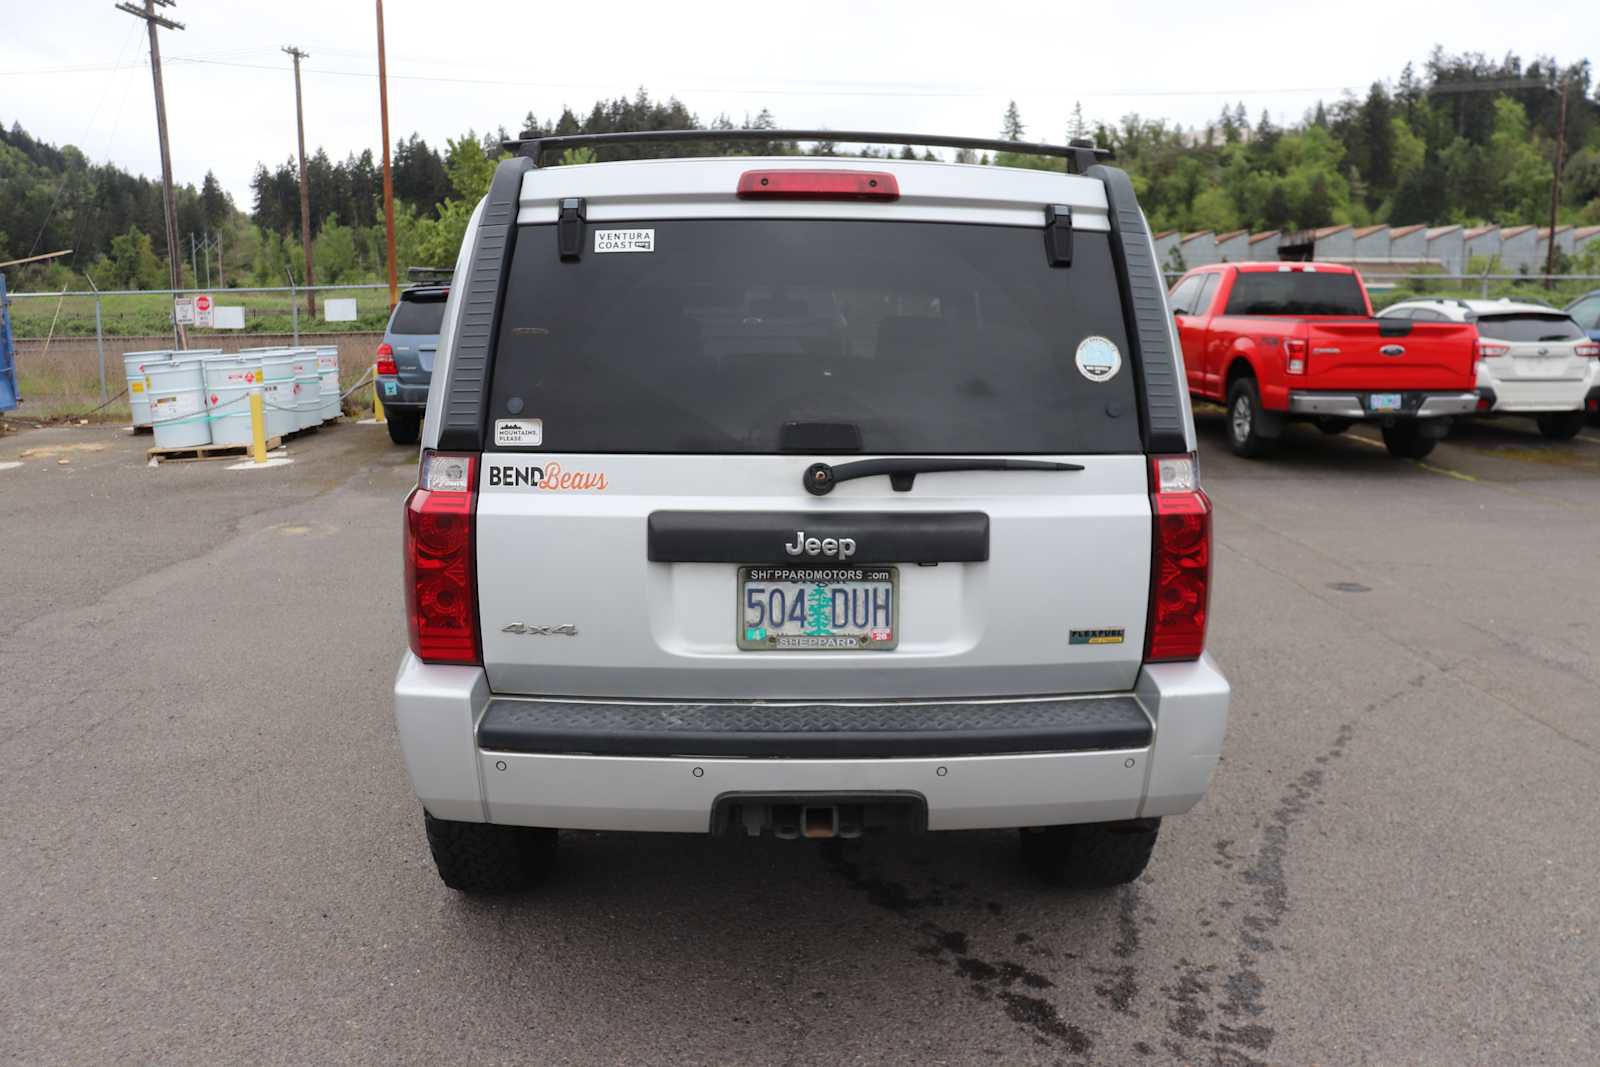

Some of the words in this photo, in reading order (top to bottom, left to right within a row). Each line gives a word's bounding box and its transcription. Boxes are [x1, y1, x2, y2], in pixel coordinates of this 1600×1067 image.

[599, 232, 650, 240] VENTURA
[598, 241, 632, 249] COAST
[489, 466, 544, 487] BEND
[785, 531, 856, 560] Jeep
[746, 588, 807, 628] 504
[831, 588, 890, 627] DUH
[501, 622, 578, 636] 4x4
[778, 637, 857, 647] SHEPPARD
